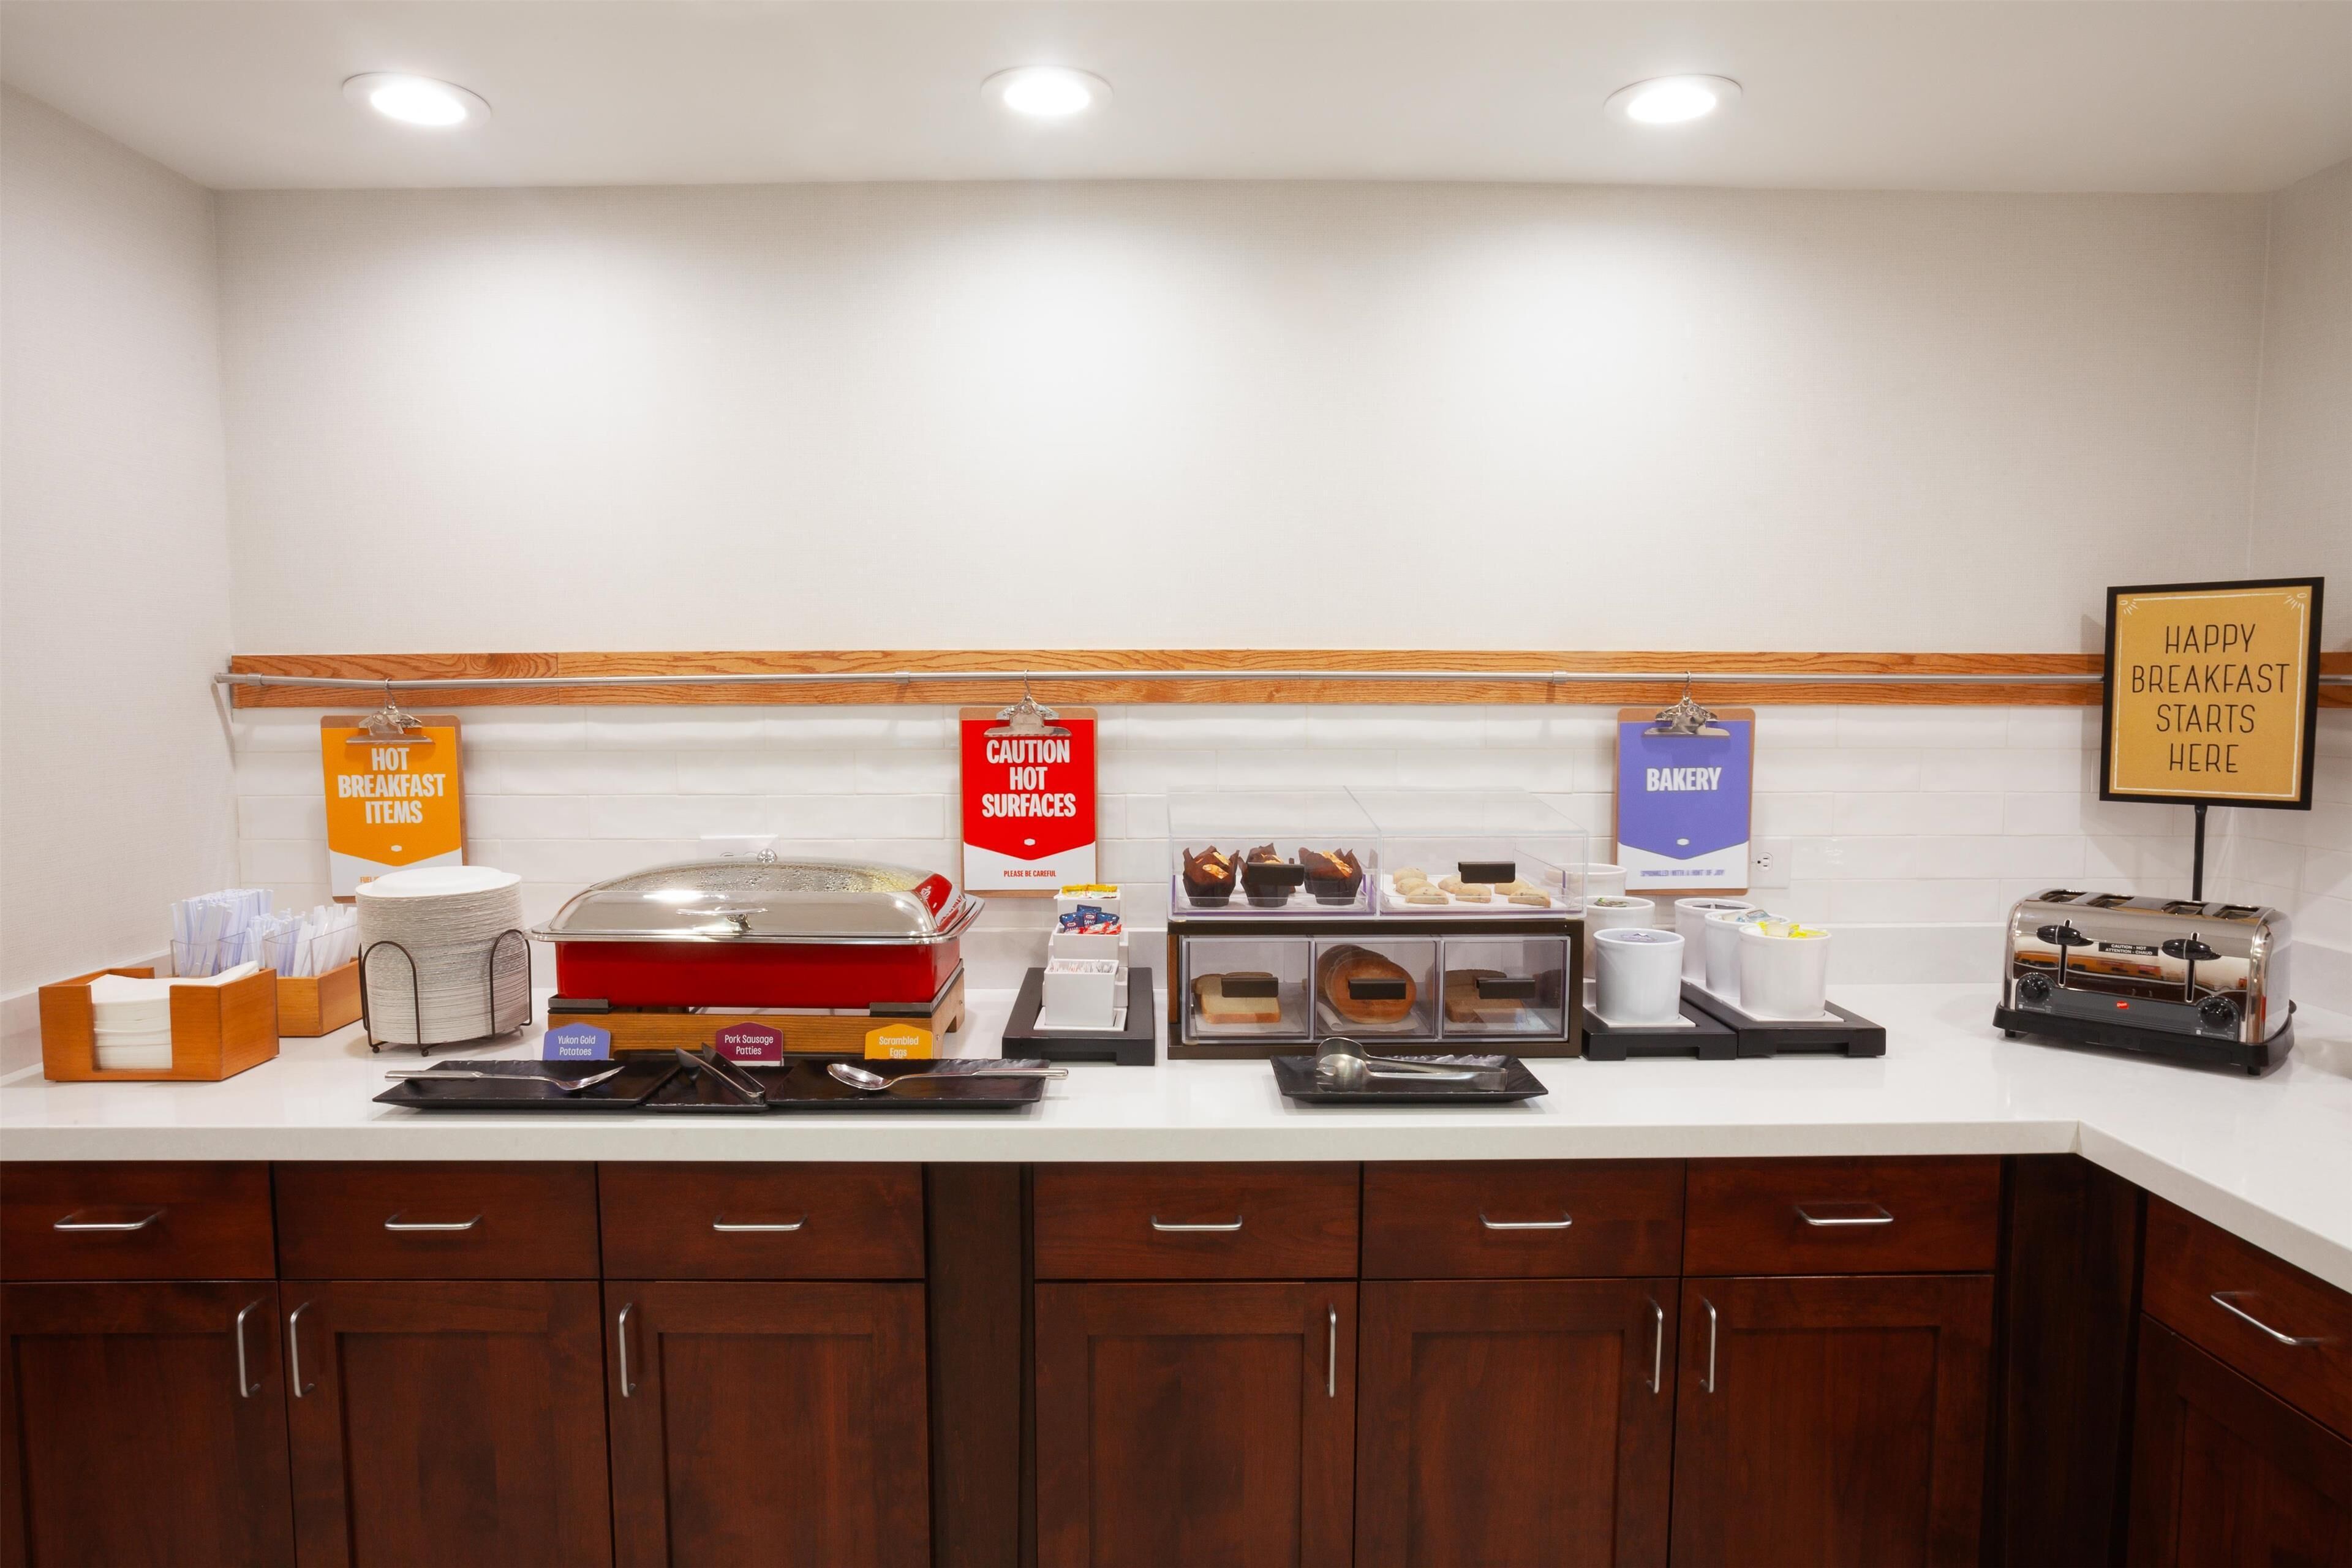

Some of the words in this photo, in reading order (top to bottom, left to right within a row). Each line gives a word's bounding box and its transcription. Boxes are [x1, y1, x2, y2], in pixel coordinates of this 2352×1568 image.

[2165, 624, 2256, 654] HAPPY
[2132, 663, 2290, 693] BREAKFAST
[2157, 704, 2255, 733] STARTS
[371, 747, 410, 771] HOT
[986, 739, 1071, 764] CAUTION
[2169, 743, 2239, 773] HERE
[337, 773, 446, 798] BREAKFAST
[1009, 766, 1048, 791] HOT
[1646, 767, 1722, 791] BAKERY
[365, 800, 423, 824] ITEMS
[982, 793, 1076, 818] SURFACES
[558, 1035, 579, 1044] Yukon
[579, 1035, 596, 1044] Gold
[559, 1047, 592, 1056] Potatoes
[725, 1035, 741, 1044] Pork
[742, 1035, 774, 1046] Sausage
[736, 1046, 762, 1055] Patties
[879, 1036, 919, 1045] Scrambled
[890, 1047, 907, 1059] Eggs
